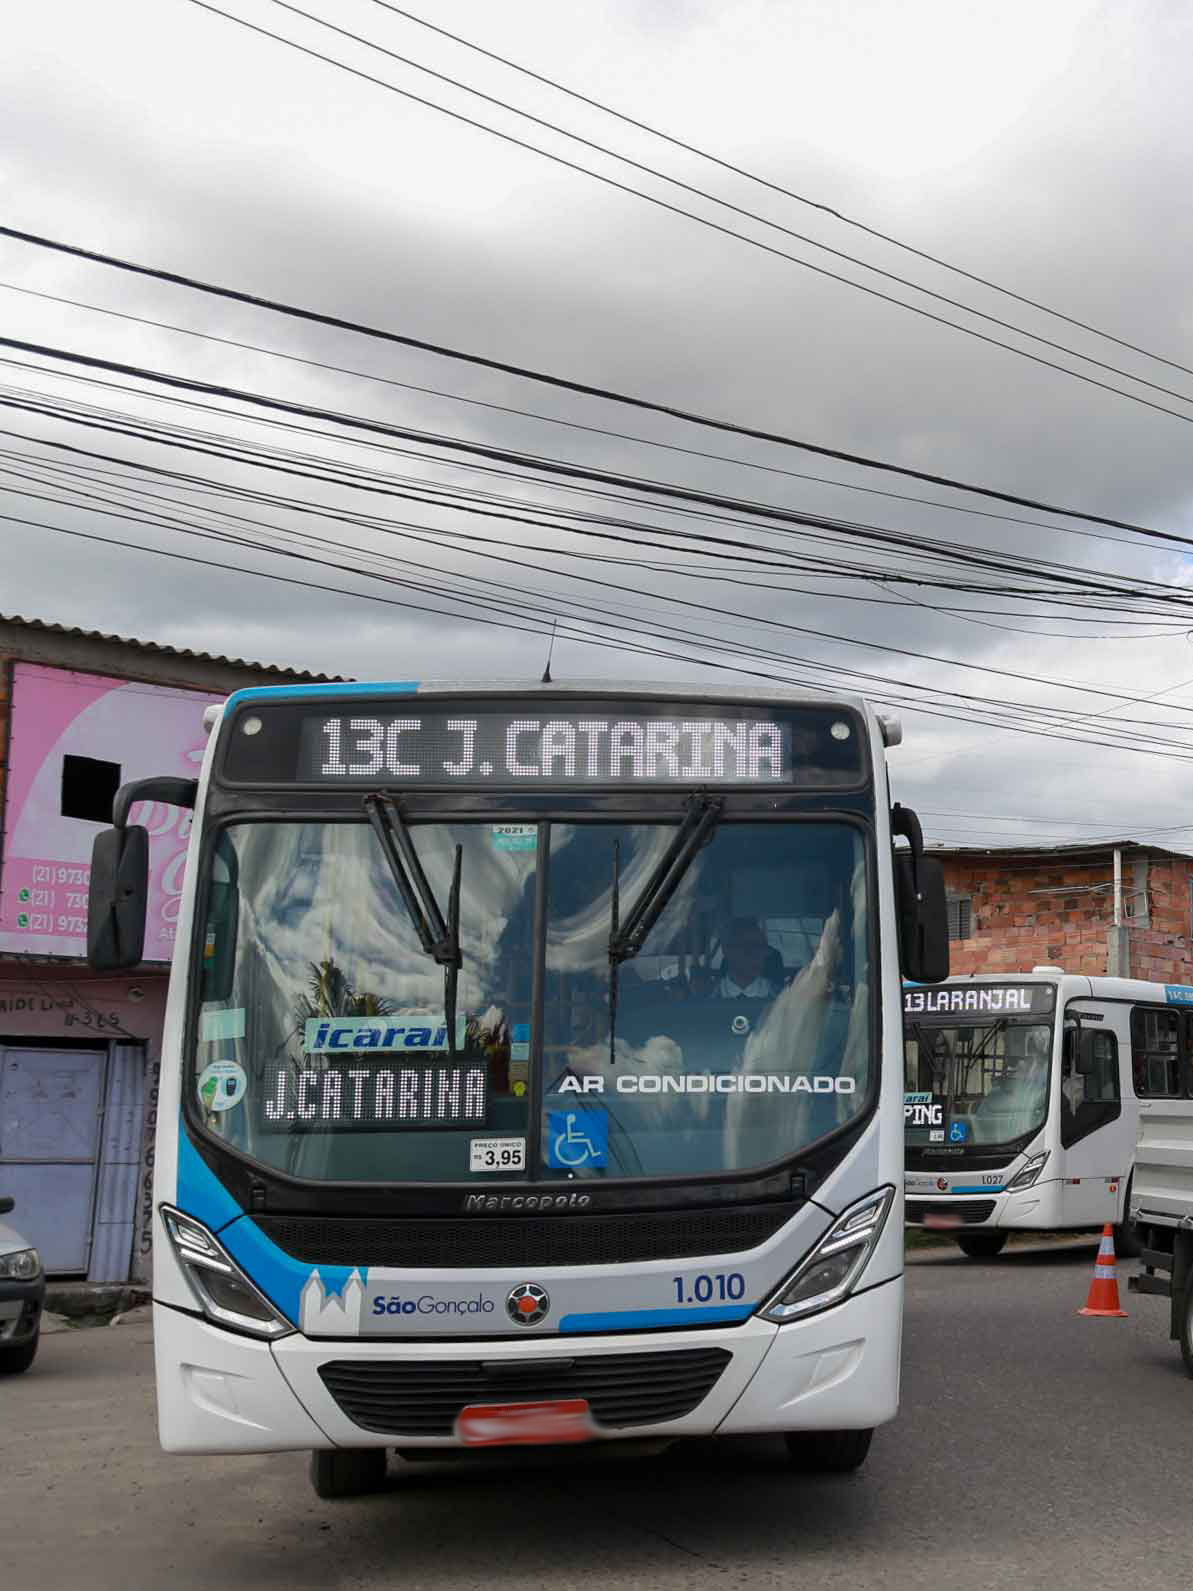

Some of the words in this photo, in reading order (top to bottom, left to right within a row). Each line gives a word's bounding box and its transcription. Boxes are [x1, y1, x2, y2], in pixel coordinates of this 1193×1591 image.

[322, 719, 422, 776] 13C
[265, 1068, 485, 1120] J.CATARINA
[558, 1074, 605, 1094] AR
[616, 1074, 857, 1095] CONDICIONADO
[485, 1150, 522, 1168] 3,95
[466, 1192, 591, 1212] Marcopolo
[672, 1274, 745, 1304] 1.010
